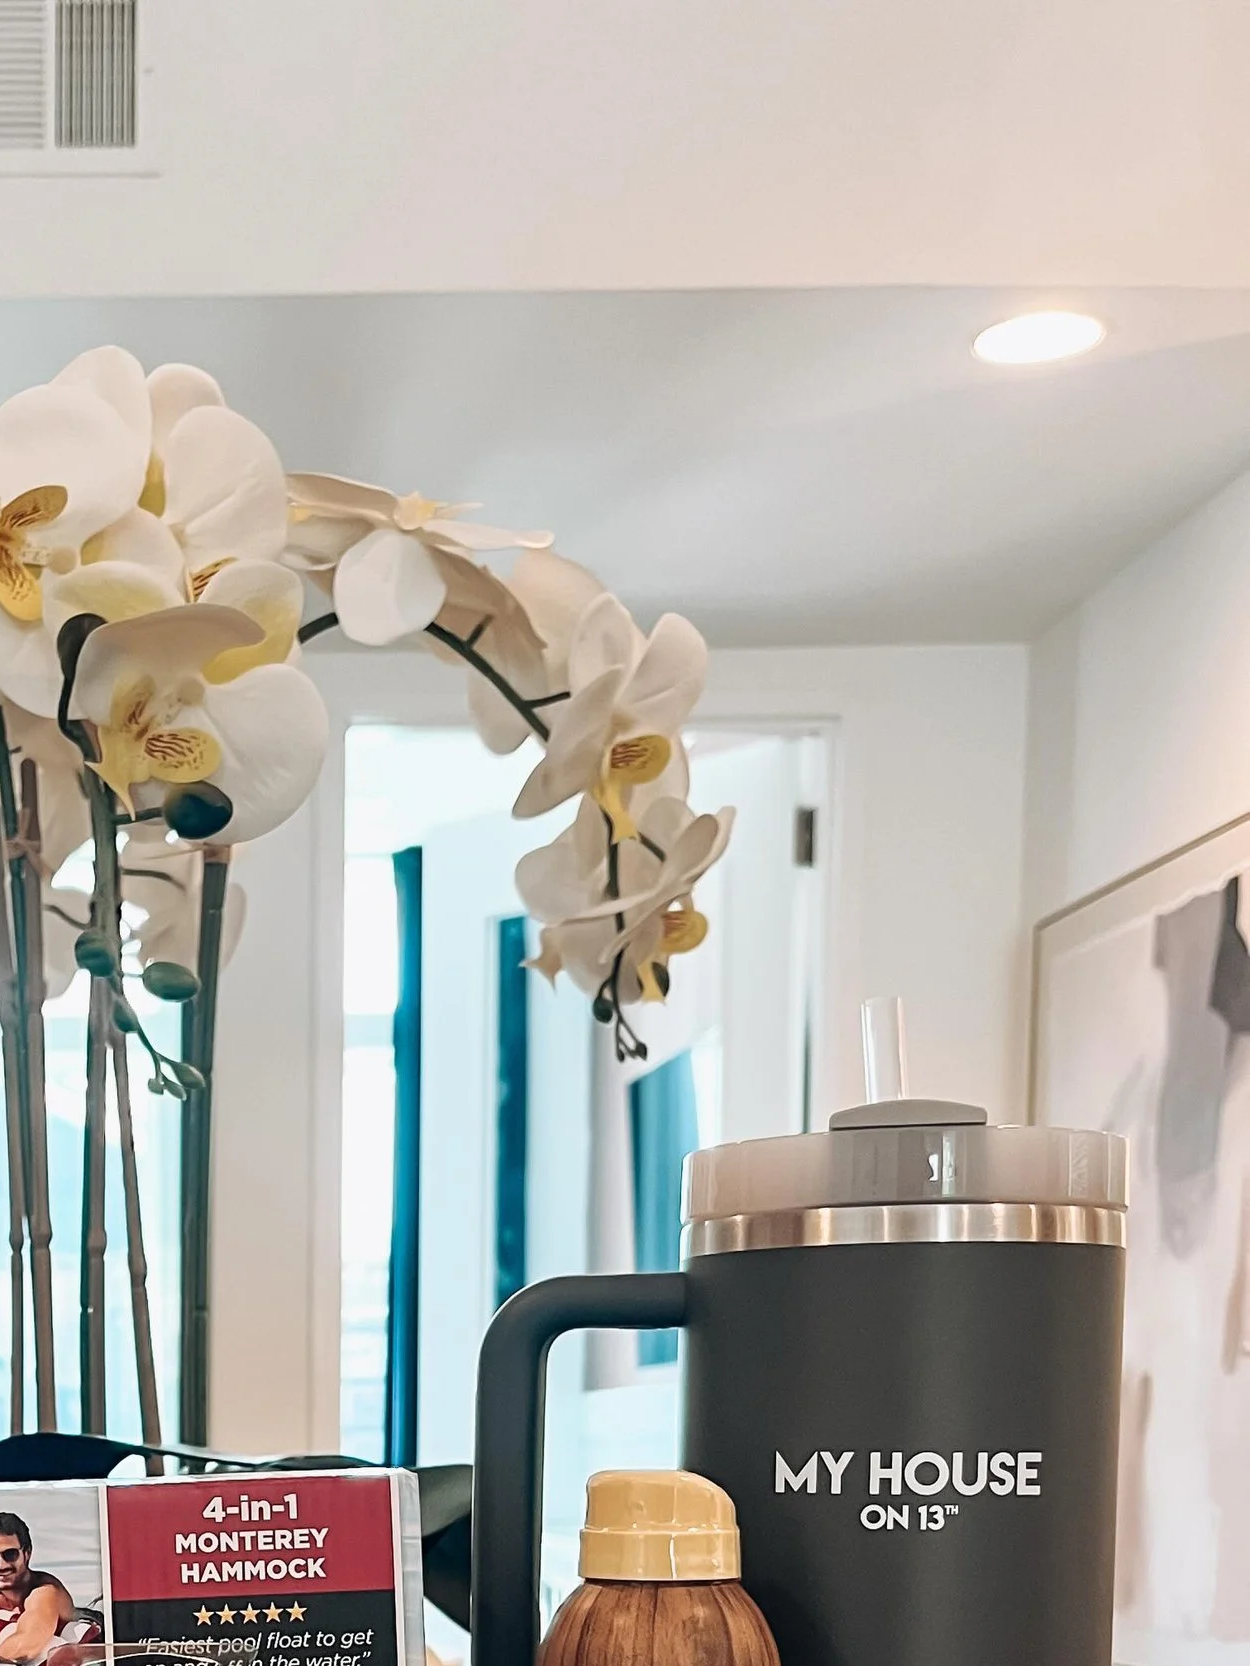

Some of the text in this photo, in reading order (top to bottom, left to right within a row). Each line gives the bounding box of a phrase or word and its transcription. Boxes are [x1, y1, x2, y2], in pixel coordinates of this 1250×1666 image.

[774, 1450, 1043, 1497] MY HOUSE
[202, 1493, 299, 1523] 4-in-1
[859, 1503, 910, 1531] ON
[174, 1527, 329, 1554] MONTEREY
[180, 1557, 327, 1584] HAMMOCK
[216, 1632, 263, 1657] pool
[266, 1632, 311, 1650] float
[315, 1633, 335, 1647] to
[340, 1629, 375, 1649] get
